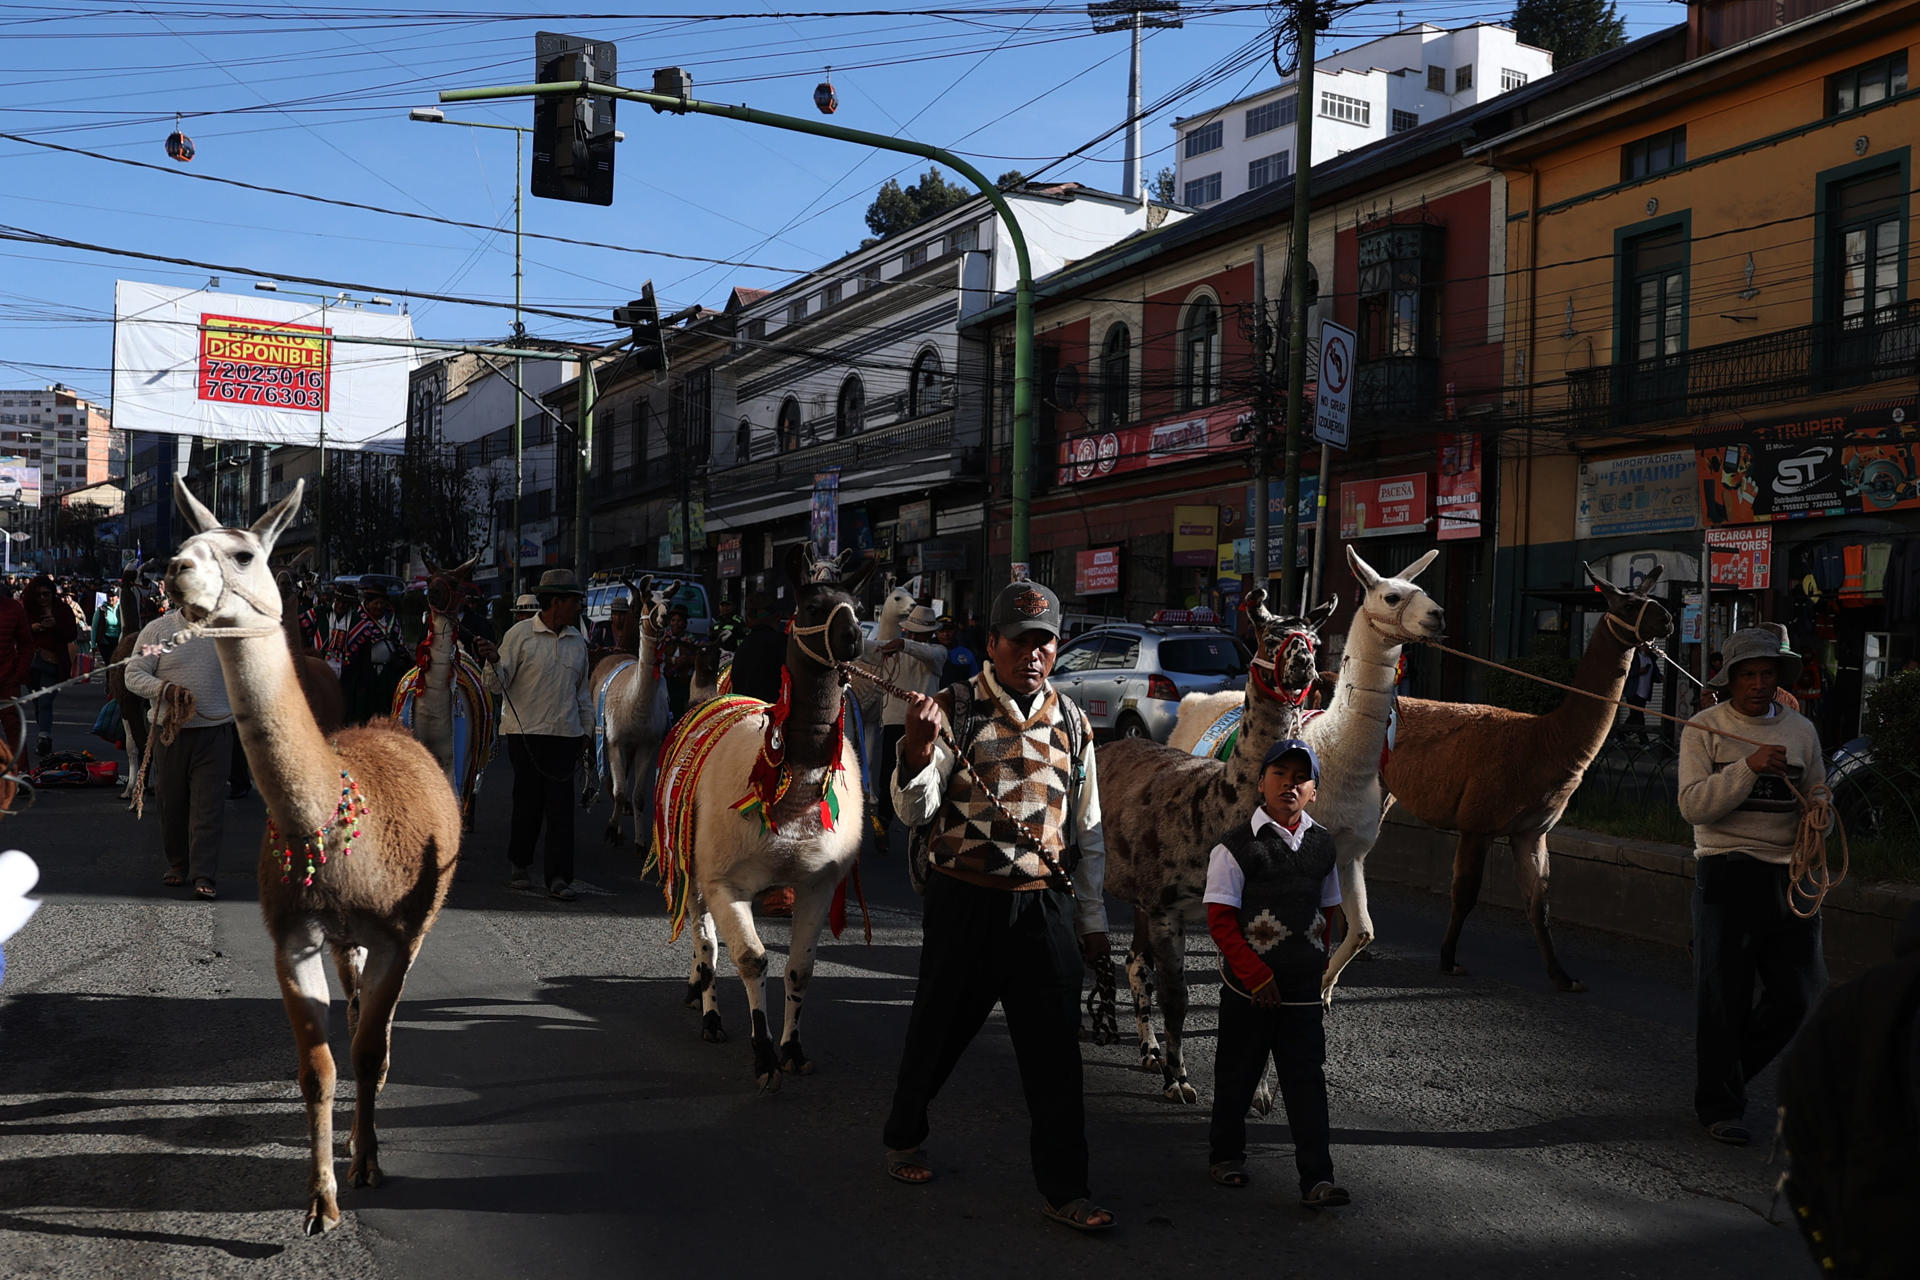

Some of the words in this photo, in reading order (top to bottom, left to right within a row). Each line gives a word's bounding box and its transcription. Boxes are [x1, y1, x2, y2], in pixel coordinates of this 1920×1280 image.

[228, 324, 306, 346] ESPACIO
[210, 340, 322, 365] DISPONIBLE
[207, 361, 322, 387] 72025016
[206, 381, 322, 407] 76776303
[1320, 395, 1328, 406] NO
[1330, 399, 1346, 413] GIRAR
[1773, 417, 1846, 440] TRUPER
[1612, 454, 1682, 469] IMPORTADORA
[1777, 453, 1826, 485] ST
[1381, 483, 1412, 498] PACEÑA
[1707, 529, 1753, 543] RECARGA
[1755, 527, 1769, 539] DE
[673, 745, 699, 787] TARIJA
